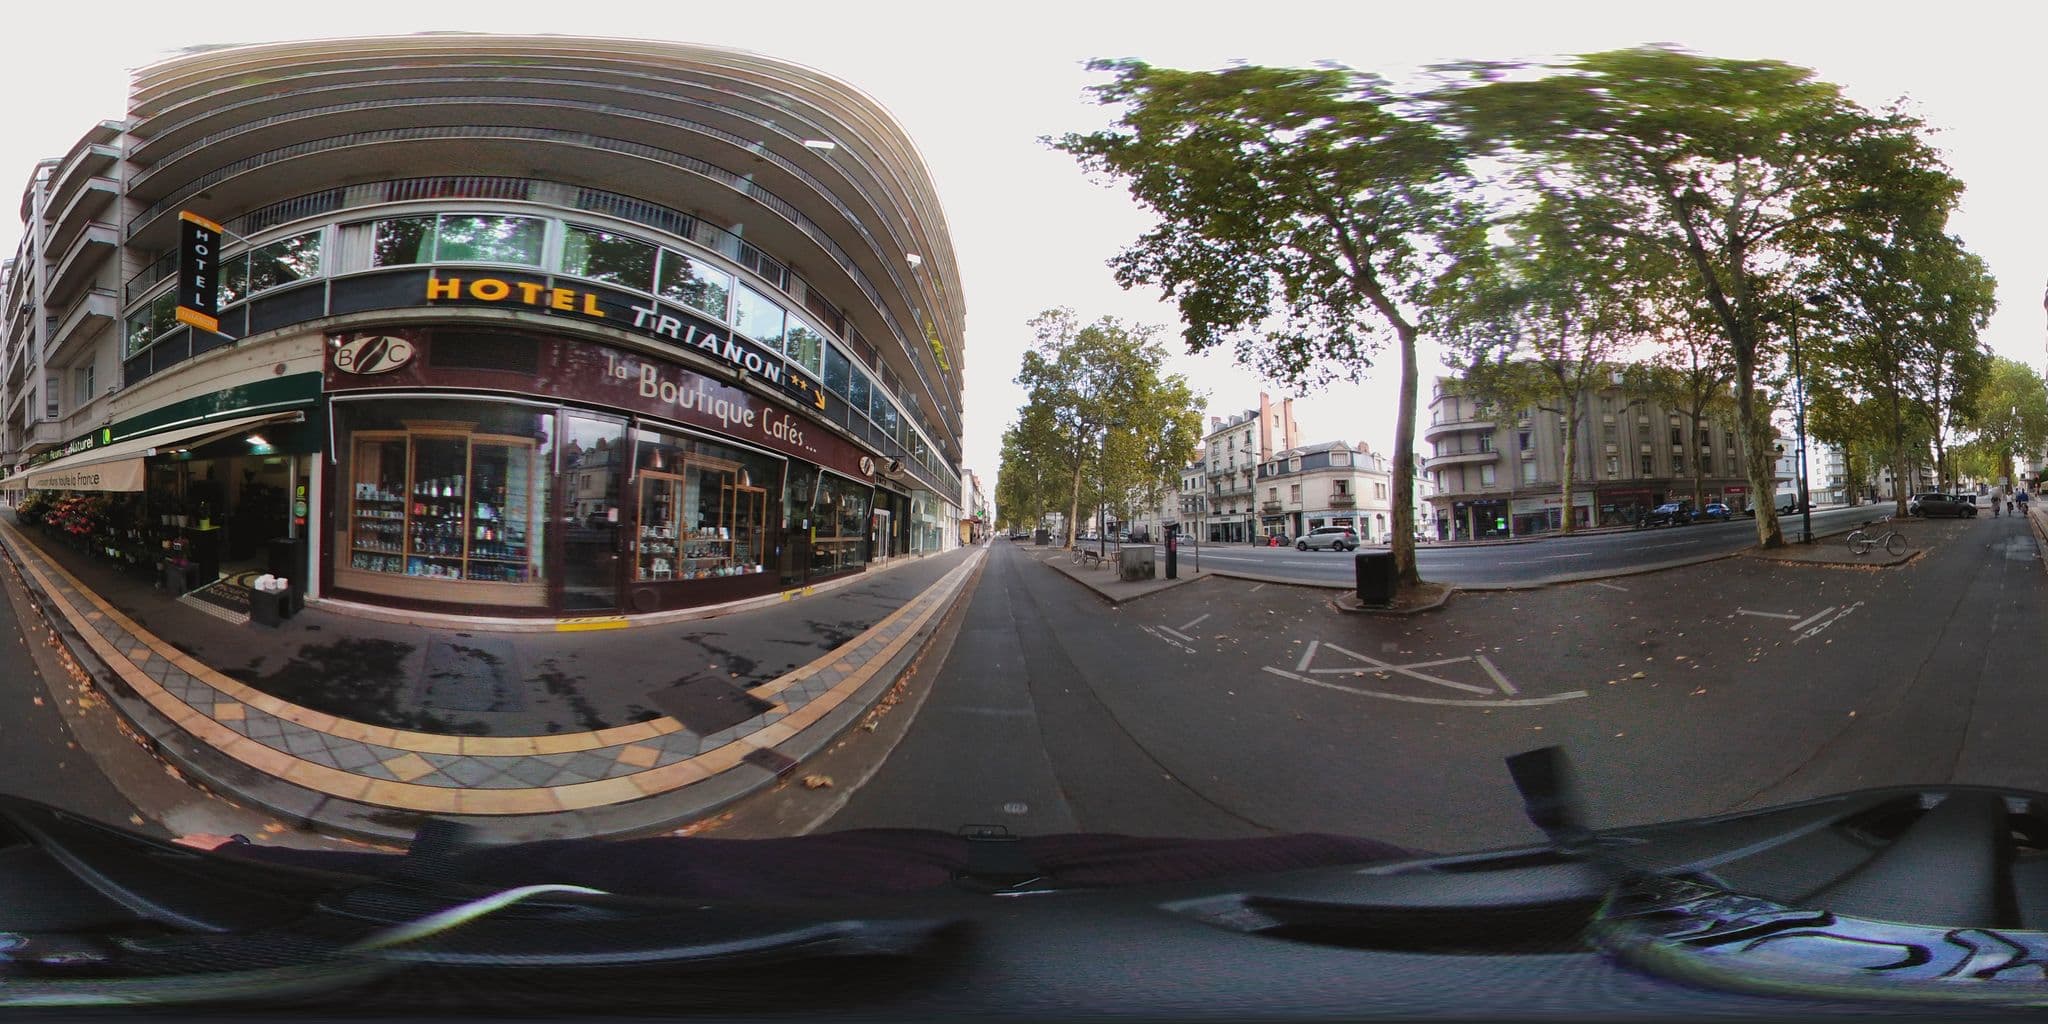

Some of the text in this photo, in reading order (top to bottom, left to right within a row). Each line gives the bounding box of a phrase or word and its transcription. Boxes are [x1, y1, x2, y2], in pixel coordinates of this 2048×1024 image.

[195, 230, 209, 307] HOTEL
[338, 345, 406, 366] B C
[427, 278, 781, 382] HOTEL TRIANON
[608, 355, 627, 379] la
[639, 363, 755, 428] Boutique
[77, 472, 100, 486] France
